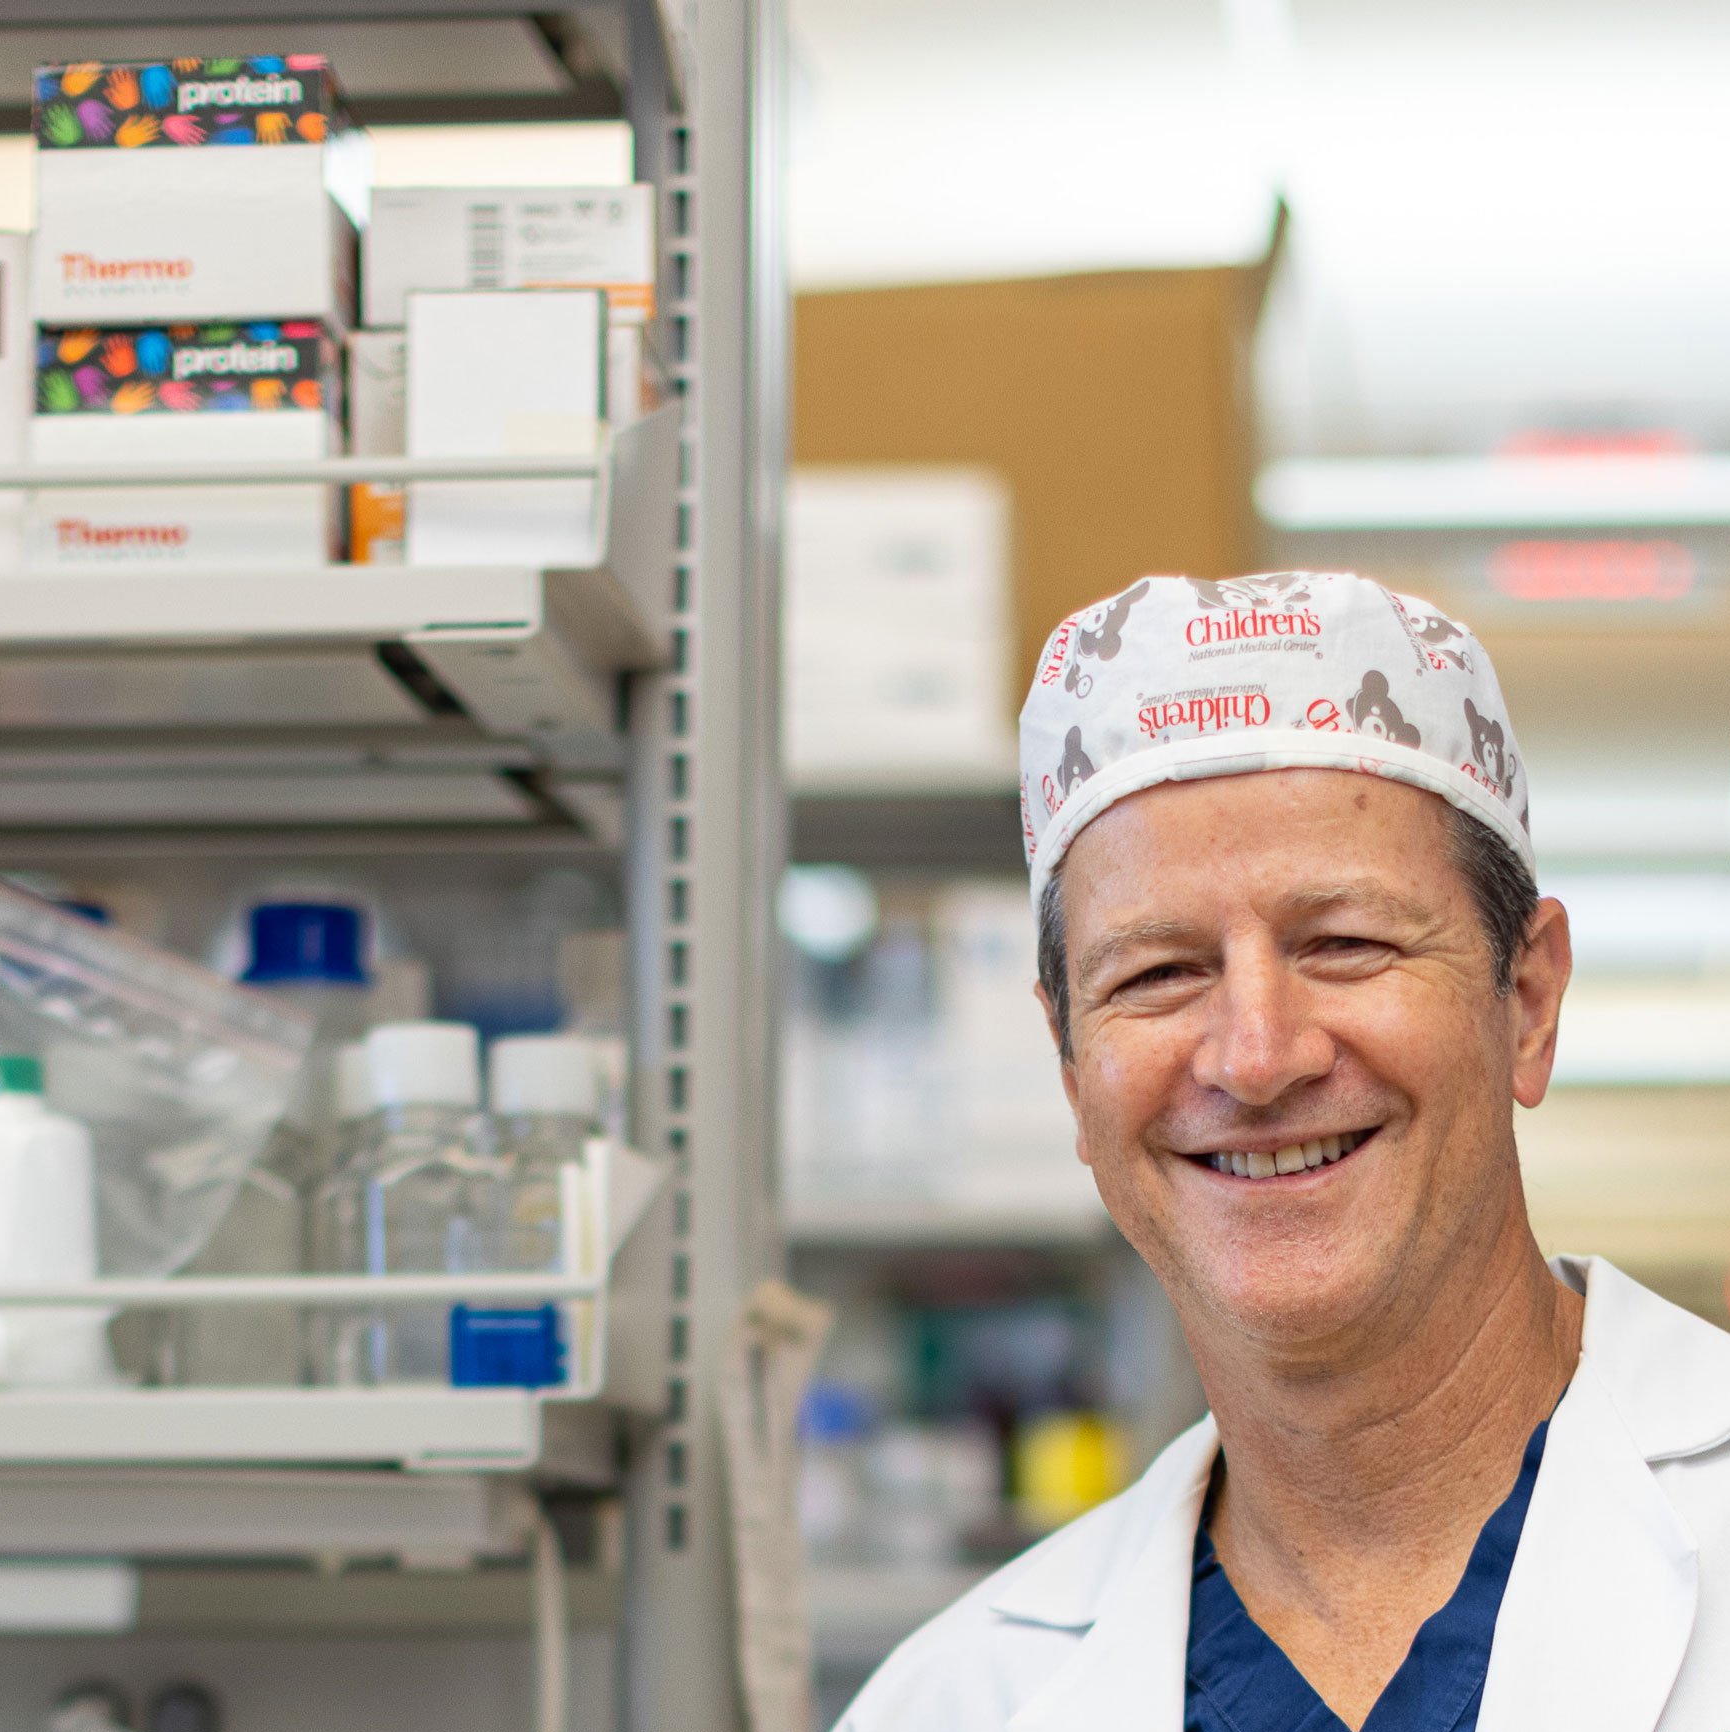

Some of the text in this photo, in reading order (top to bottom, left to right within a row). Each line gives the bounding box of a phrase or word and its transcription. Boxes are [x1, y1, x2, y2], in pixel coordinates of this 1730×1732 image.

[177, 73, 305, 114] protein
[58, 253, 195, 282] Thermo
[172, 340, 301, 381] protein
[55, 517, 190, 552] Thermo
[1186, 608, 1321, 647] Children's
[1188, 639, 1318, 663] National Medical Center
[1173, 687, 1217, 703] Medical
[1218, 683, 1268, 696] National
[1138, 694, 1270, 740] Children's
